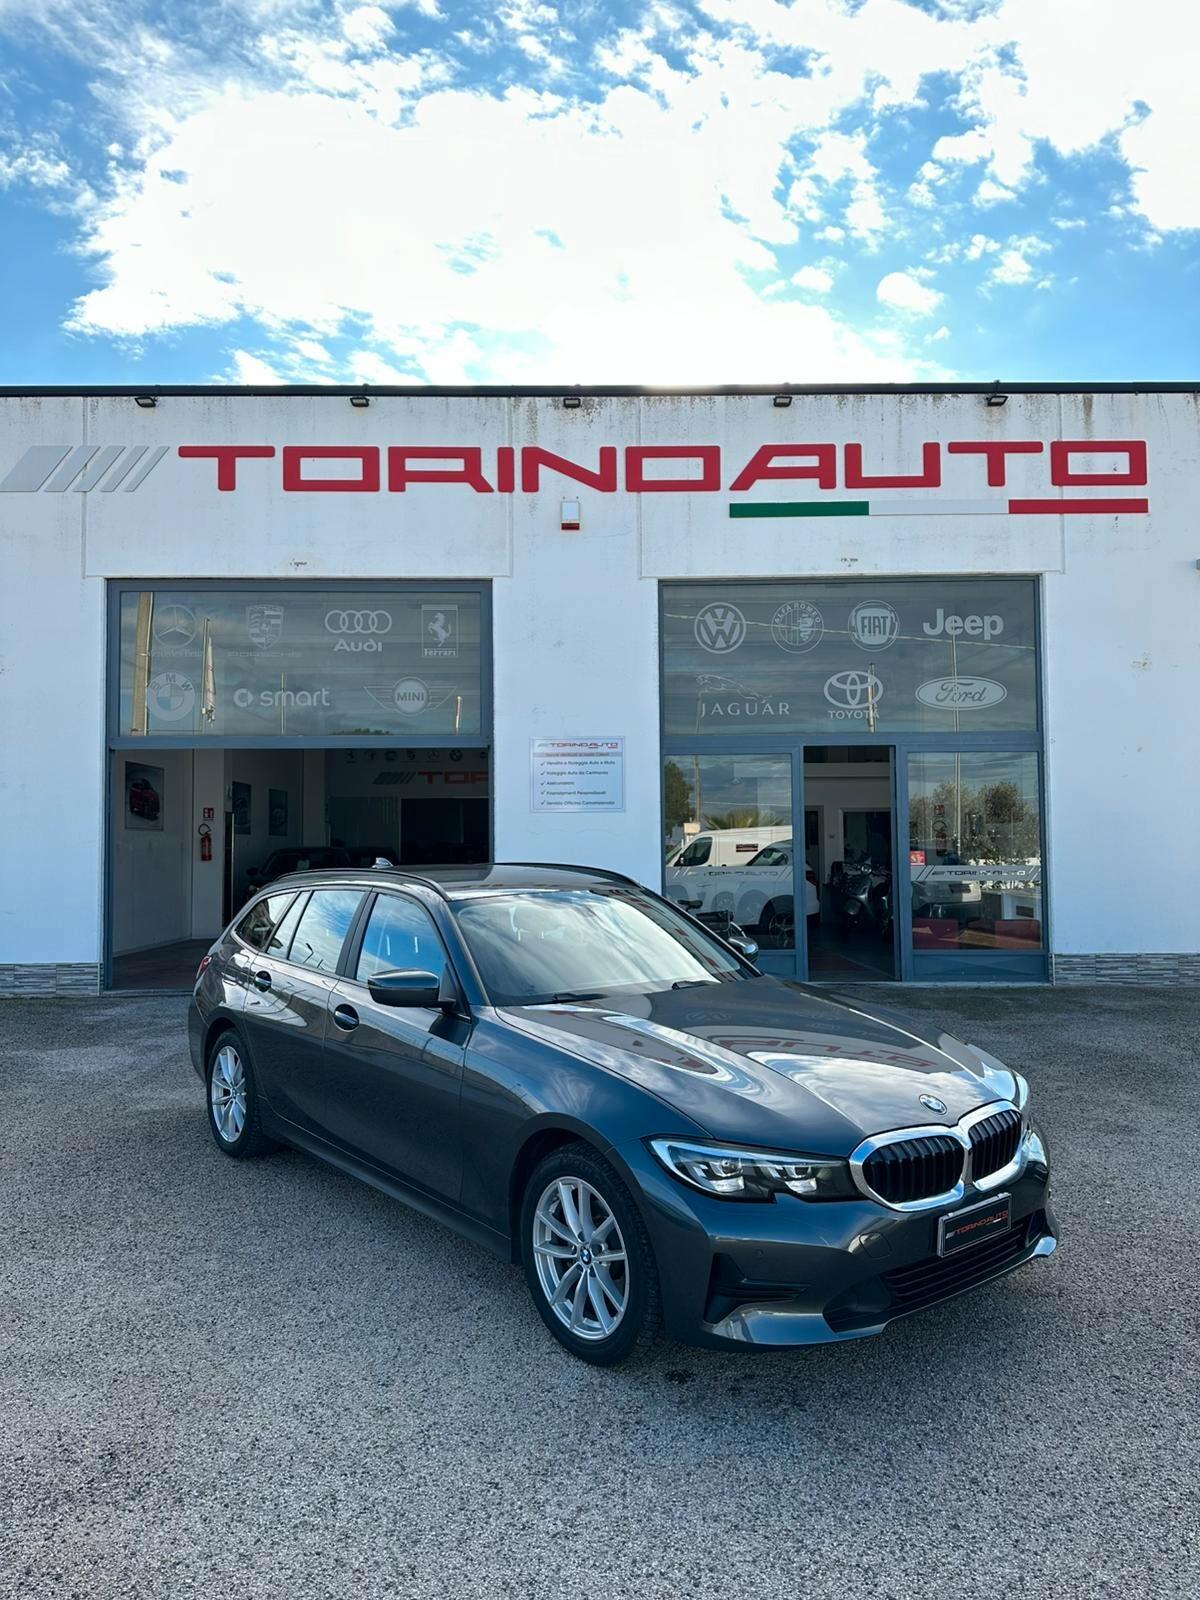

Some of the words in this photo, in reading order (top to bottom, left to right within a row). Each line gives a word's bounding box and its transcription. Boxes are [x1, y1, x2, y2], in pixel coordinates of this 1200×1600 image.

[178, 440, 1148, 493] TORINOAUTO
[861, 614, 888, 637] FIAT
[923, 608, 1004, 640] Jeep
[333, 638, 383, 652] Audi
[423, 647, 457, 657] Ferrari
[260, 688, 330, 708] smart
[397, 690, 425, 702] MINI
[936, 682, 988, 703] Ford
[700, 701, 790, 717] JAGUAR
[828, 709, 880, 720] TOYOTA
[956, 1210, 1007, 1234] TORINOAUTO
